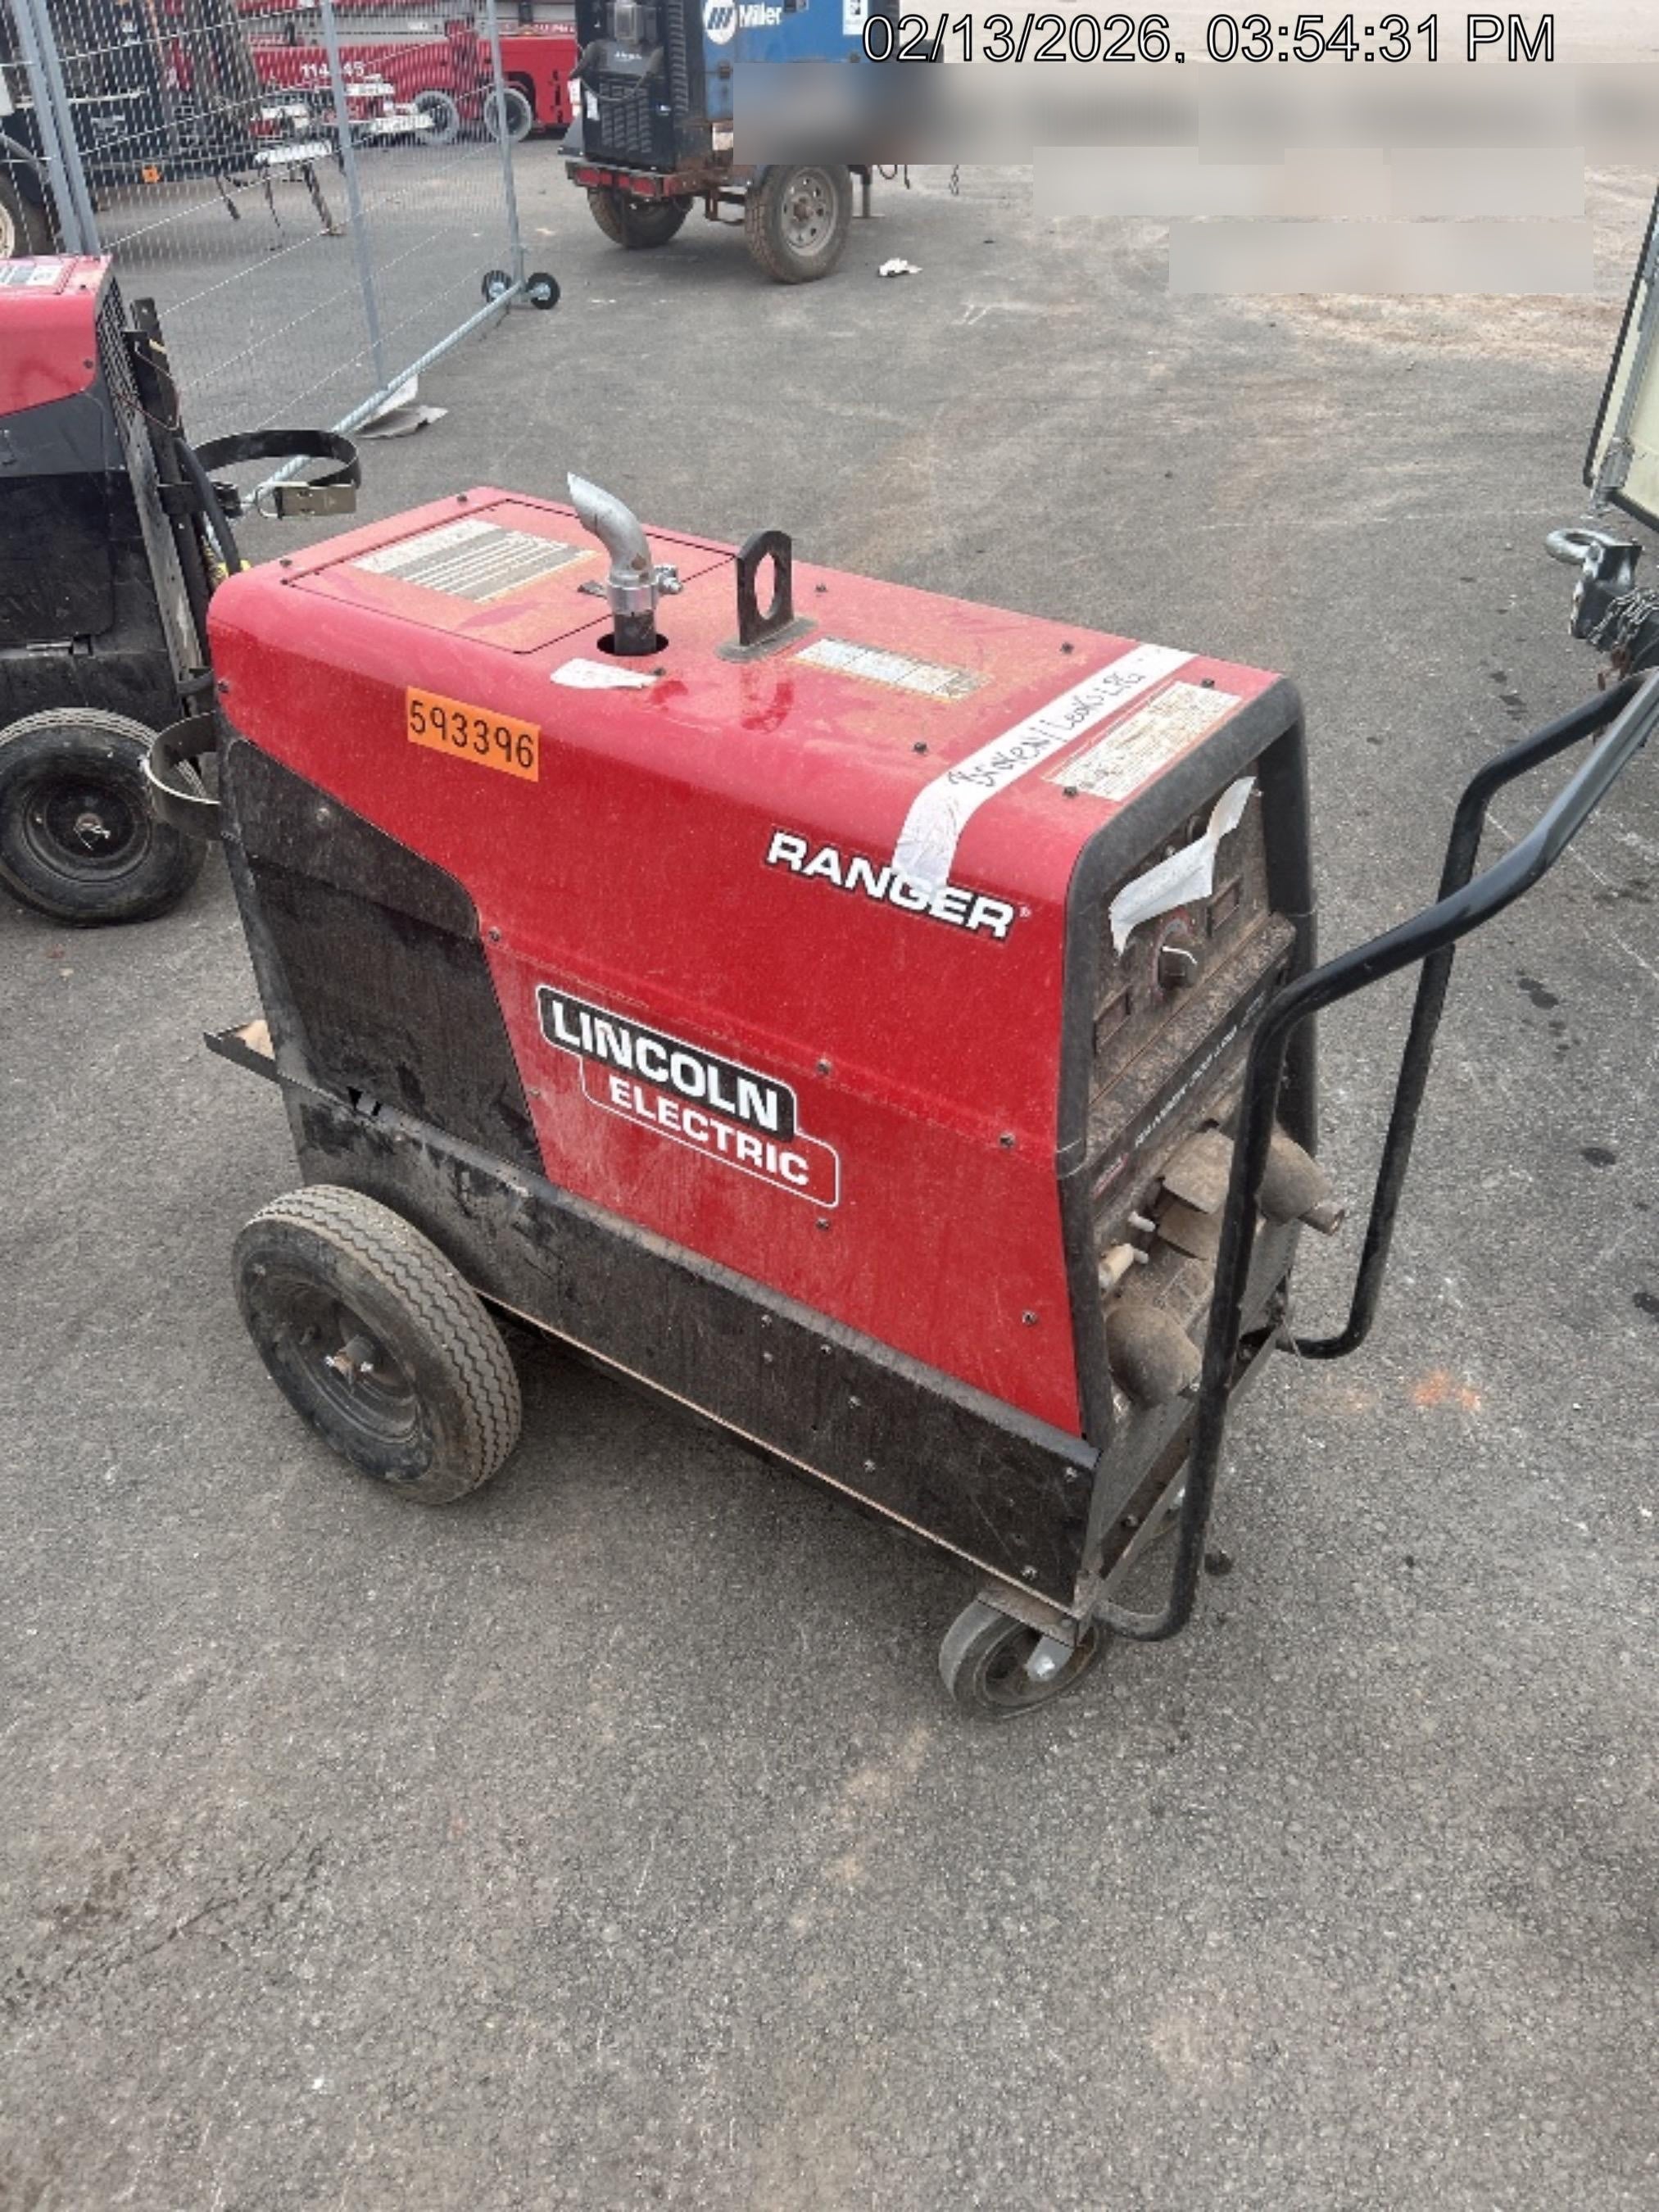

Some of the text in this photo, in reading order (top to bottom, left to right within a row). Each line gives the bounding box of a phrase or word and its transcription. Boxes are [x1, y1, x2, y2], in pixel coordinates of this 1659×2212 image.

[739, 2, 782, 28] Miller
[301, 61, 365, 77] 11445
[410, 700, 533, 768] 593396
[766, 831, 1016, 941] RANGER
[552, 999, 777, 1131] LINCOLN
[609, 1075, 809, 1185] ELECTRIC
